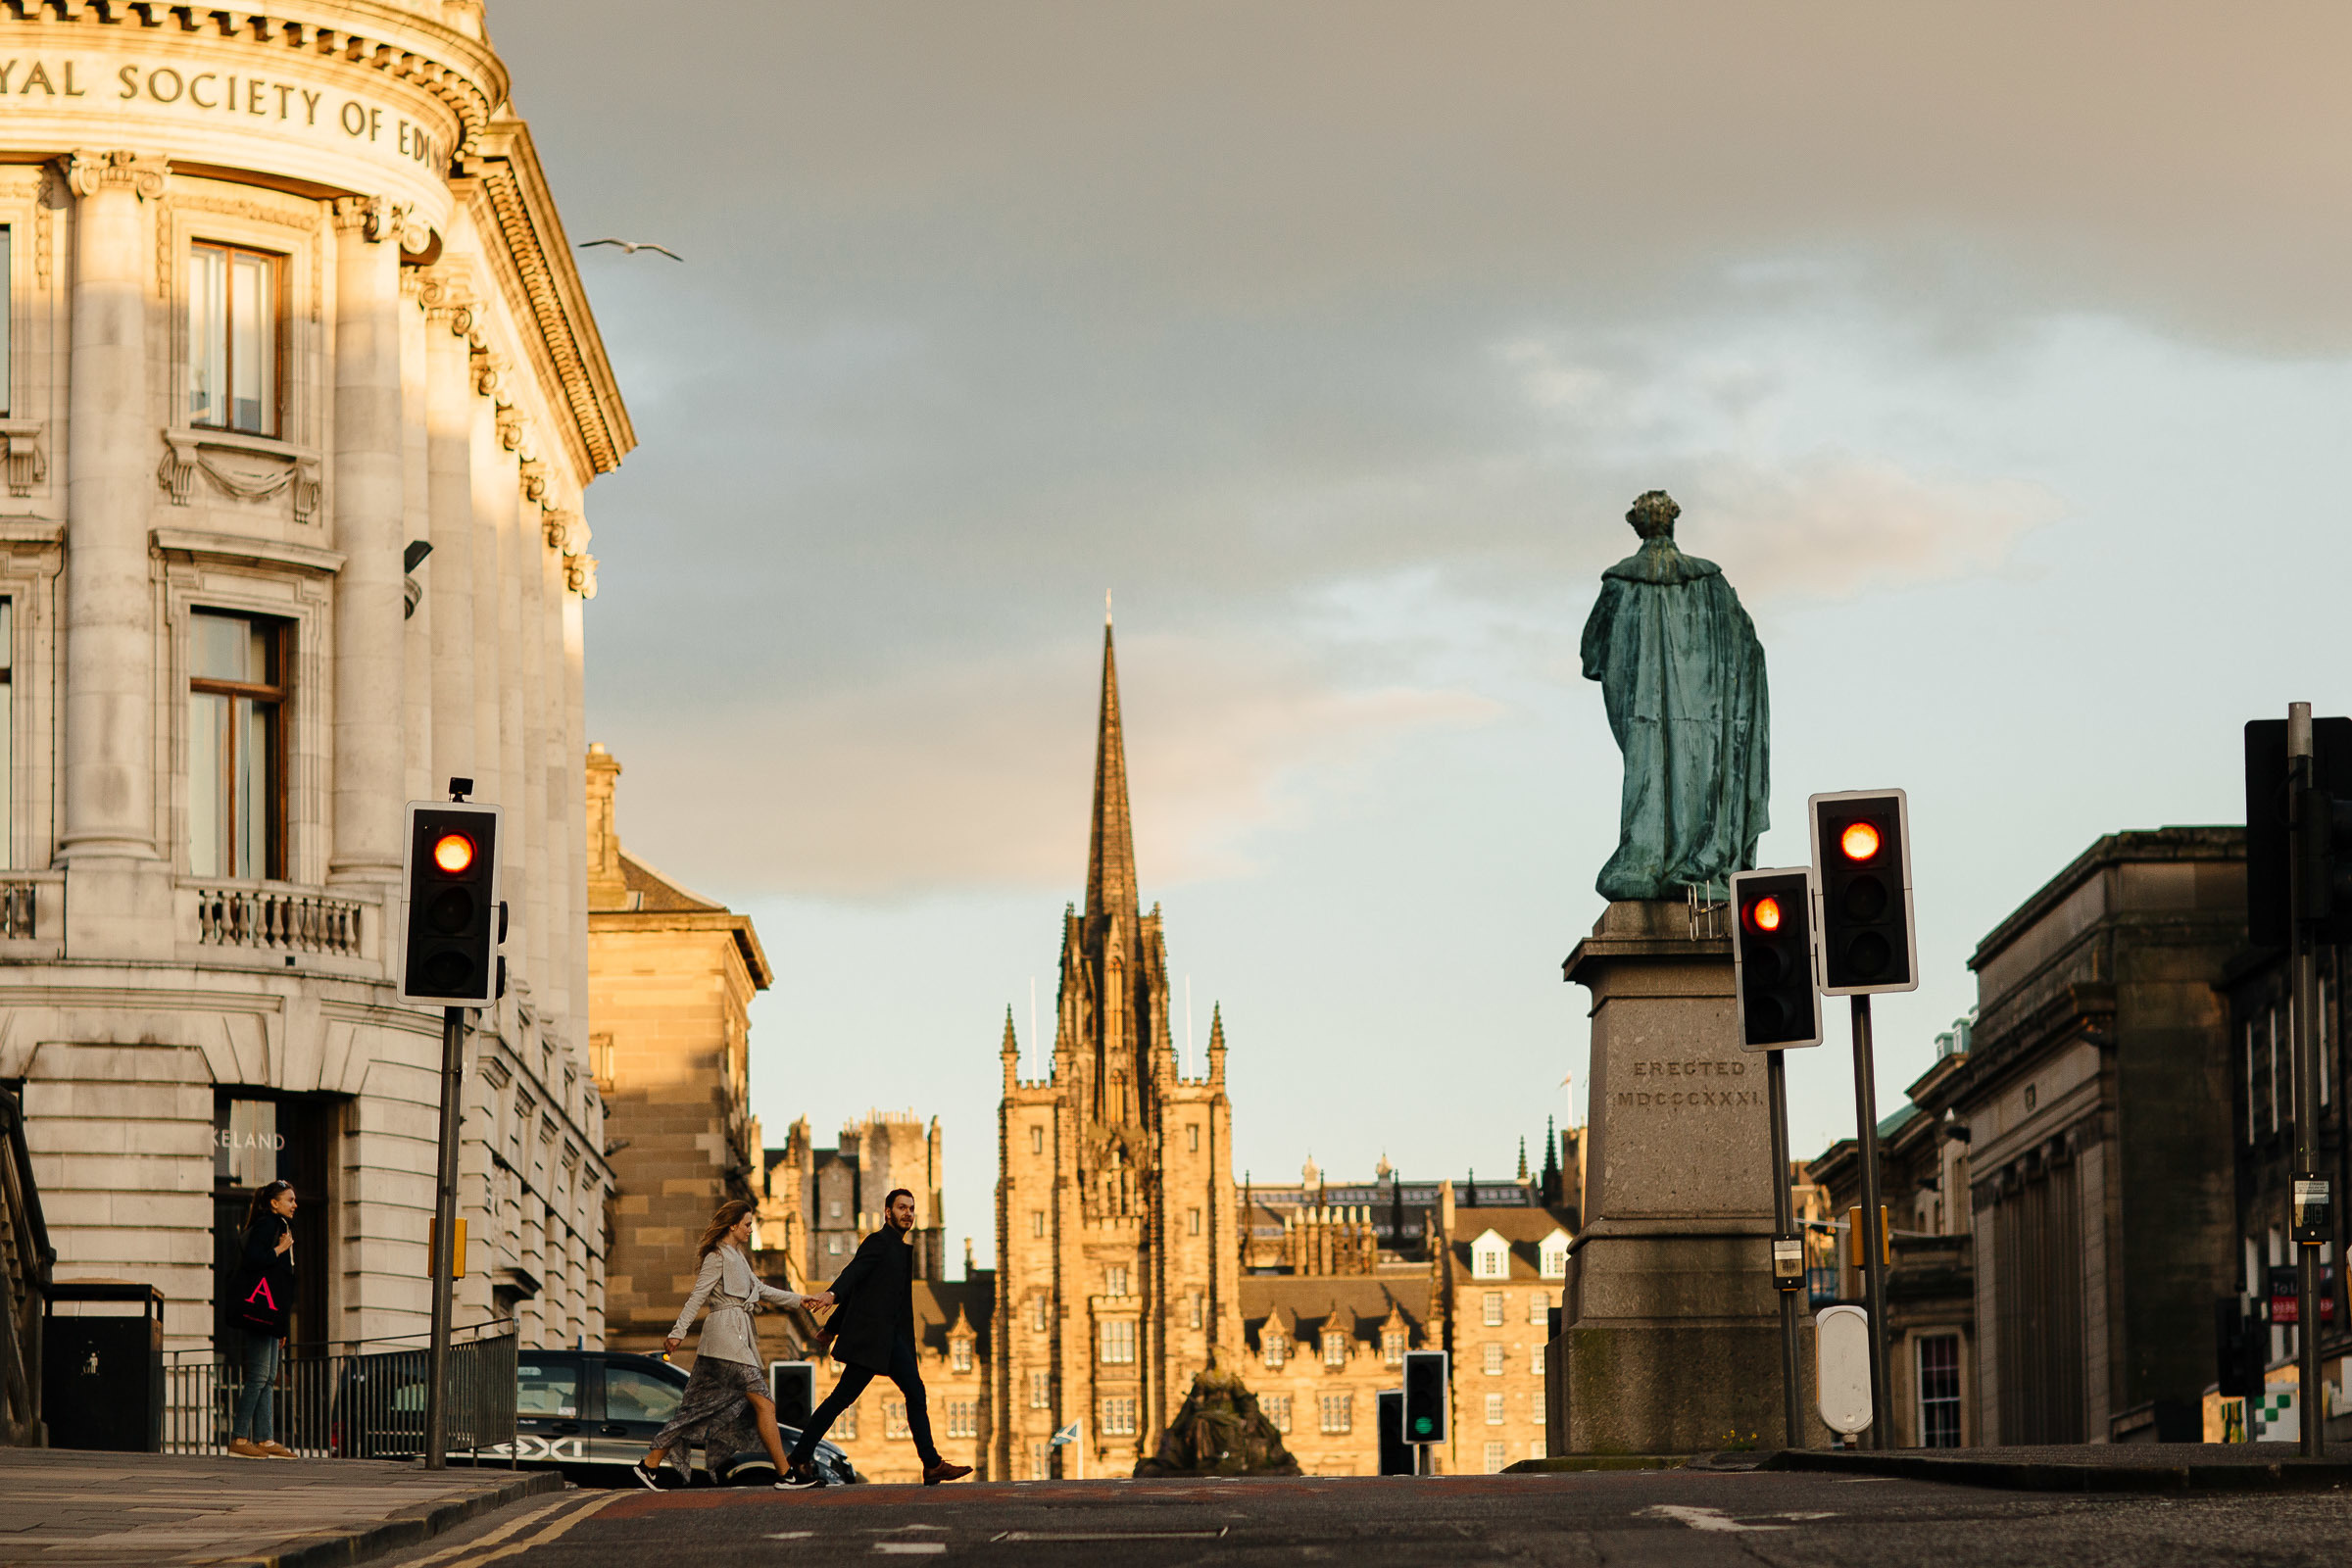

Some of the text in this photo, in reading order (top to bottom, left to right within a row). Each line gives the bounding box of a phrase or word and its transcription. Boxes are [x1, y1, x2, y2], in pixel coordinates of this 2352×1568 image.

[119, 65, 321, 125] SOCIETY
[342, 101, 382, 141] OF
[1633, 1061, 1746, 1076] ERECTED
[244, 1276, 279, 1311] A
